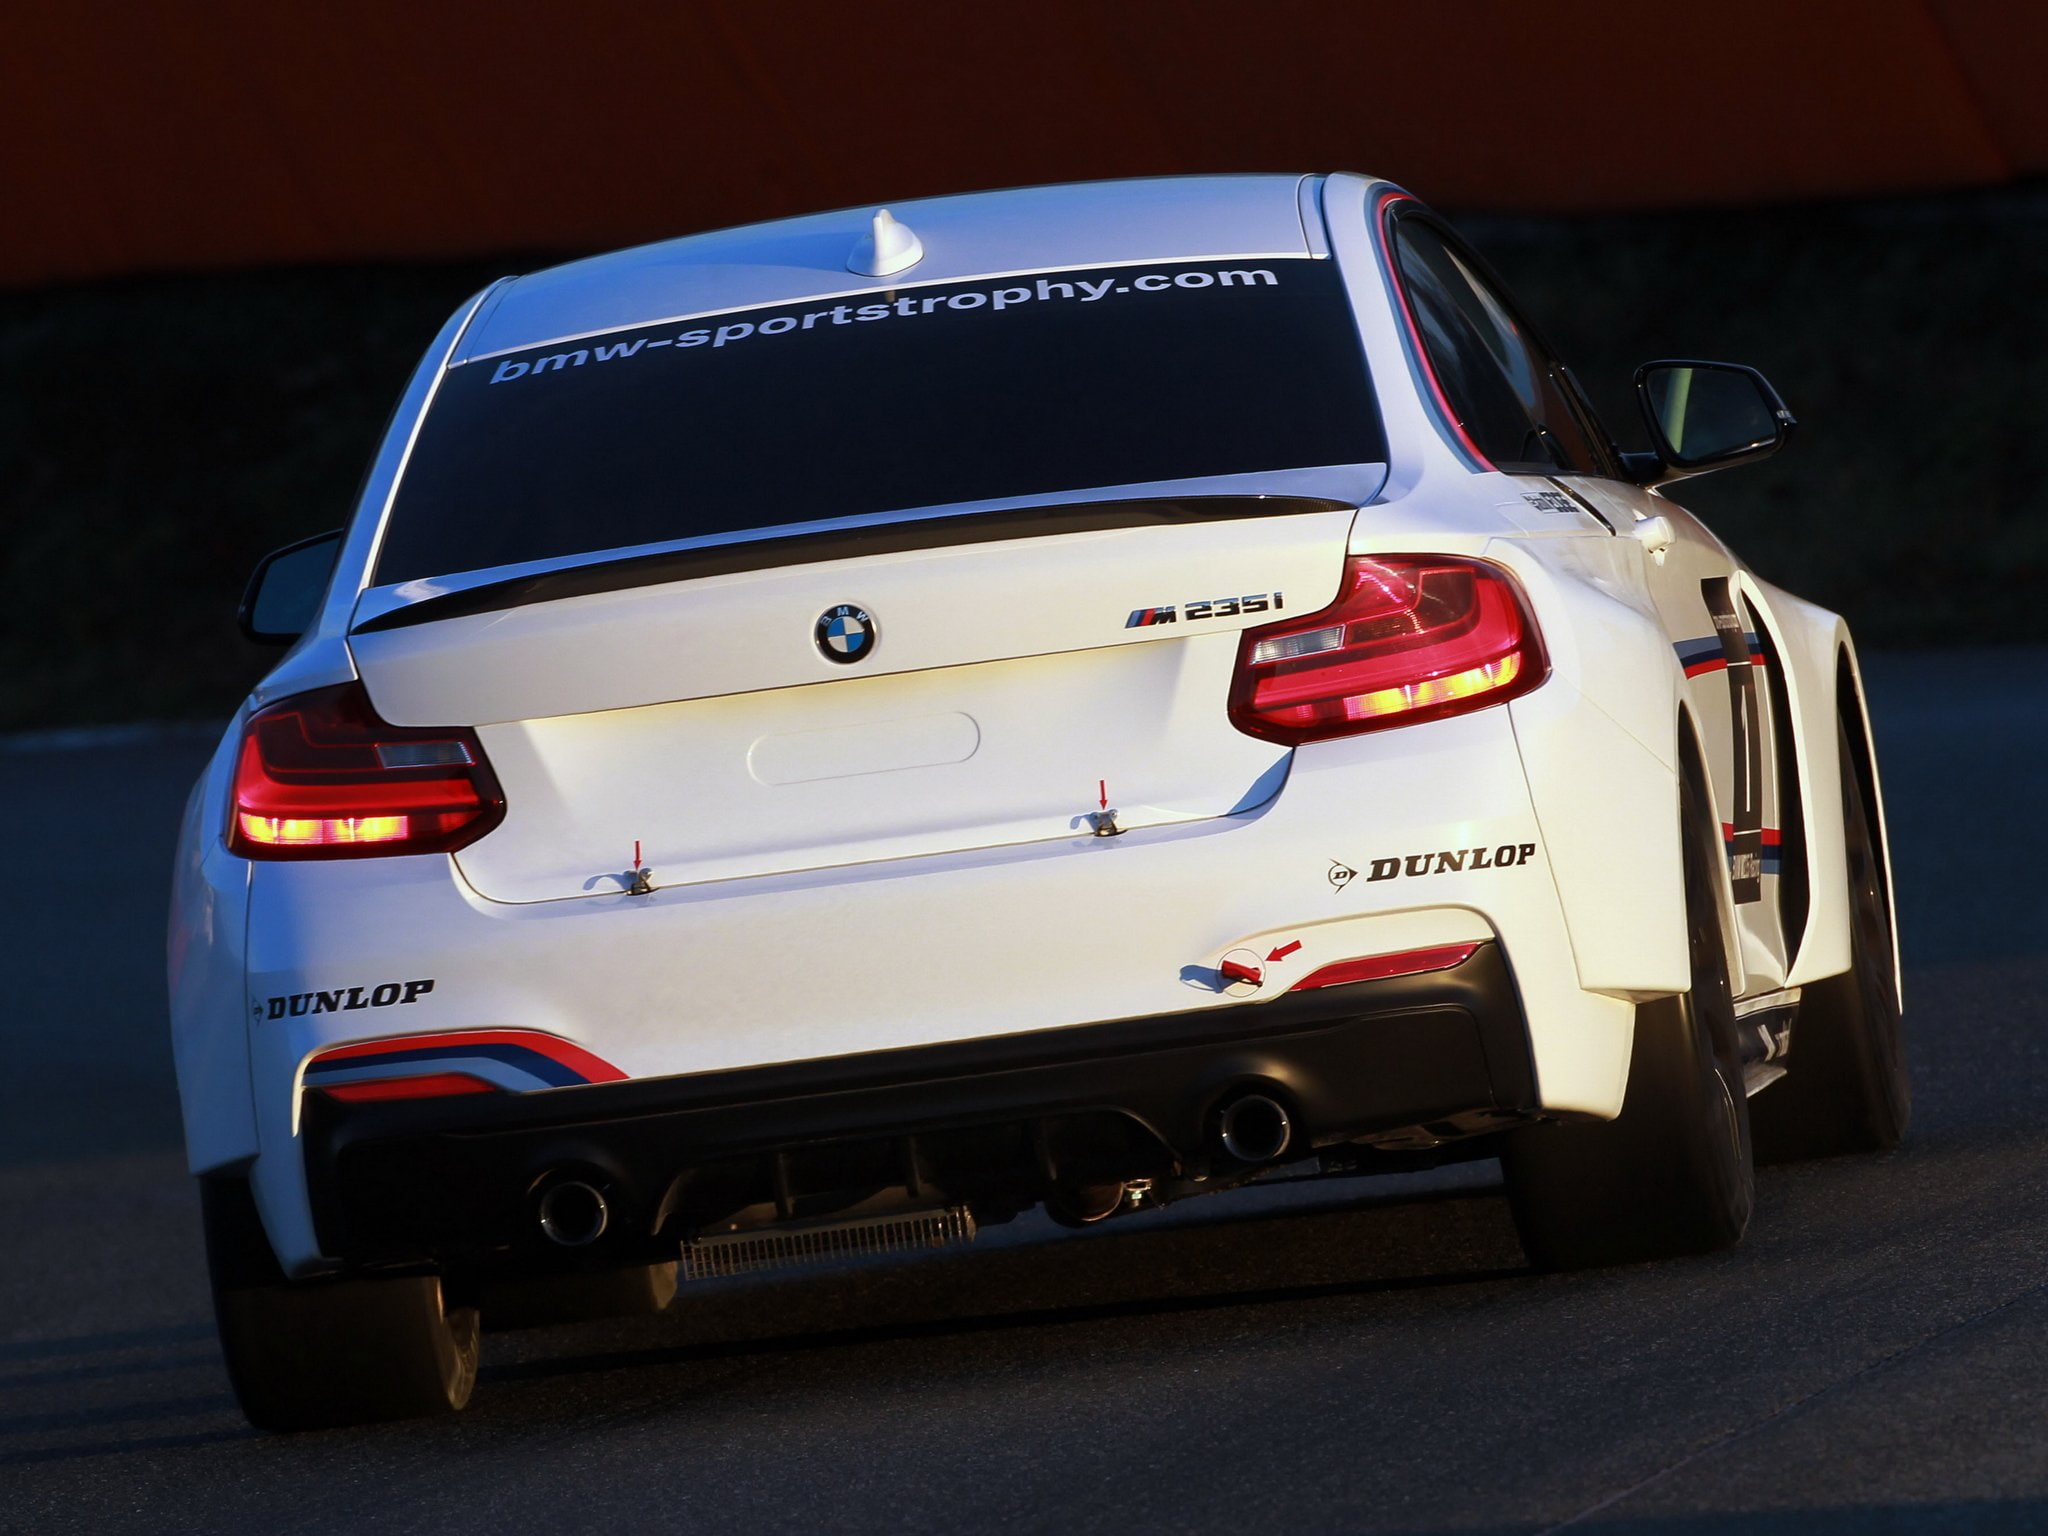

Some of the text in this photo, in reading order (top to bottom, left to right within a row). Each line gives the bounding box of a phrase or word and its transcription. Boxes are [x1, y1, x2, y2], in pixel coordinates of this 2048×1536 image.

[489, 269, 1279, 381] bmw-sportstrophy.com
[820, 606, 869, 626] BMW
[1366, 843, 1536, 882] DUNLOP
[267, 979, 435, 1020] DUNLOP
